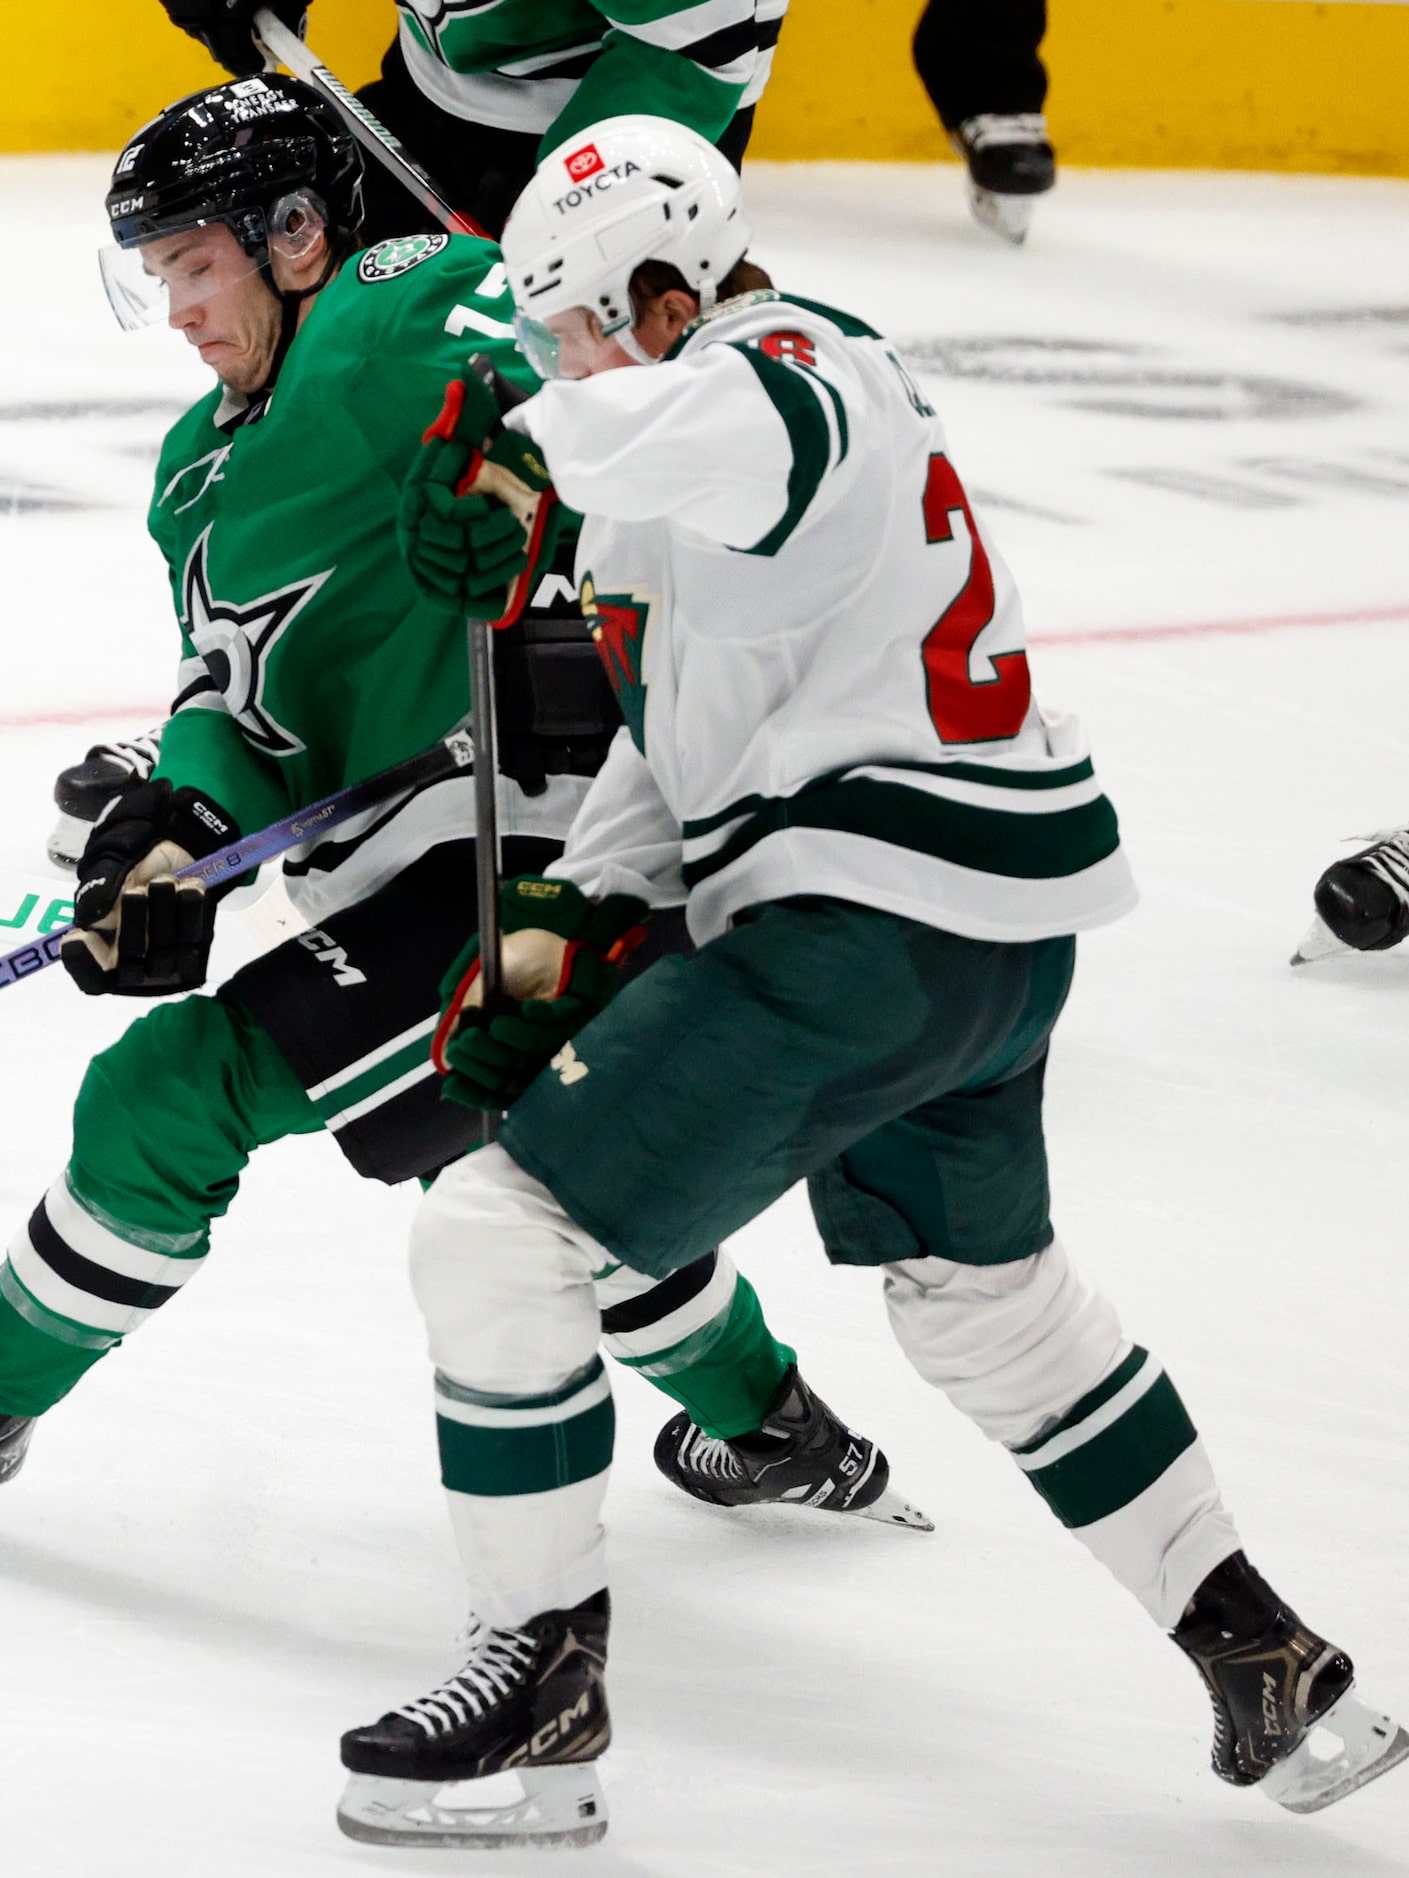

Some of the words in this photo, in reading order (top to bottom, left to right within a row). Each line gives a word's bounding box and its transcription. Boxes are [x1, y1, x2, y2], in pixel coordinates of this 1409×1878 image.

[111, 197, 144, 217] CCM
[553, 161, 641, 214] TOYOTA
[193, 801, 228, 832] CCM
[298, 927, 368, 987] CM
[838, 1442, 864, 1477] 57
[1262, 1671, 1282, 1737] CCM
